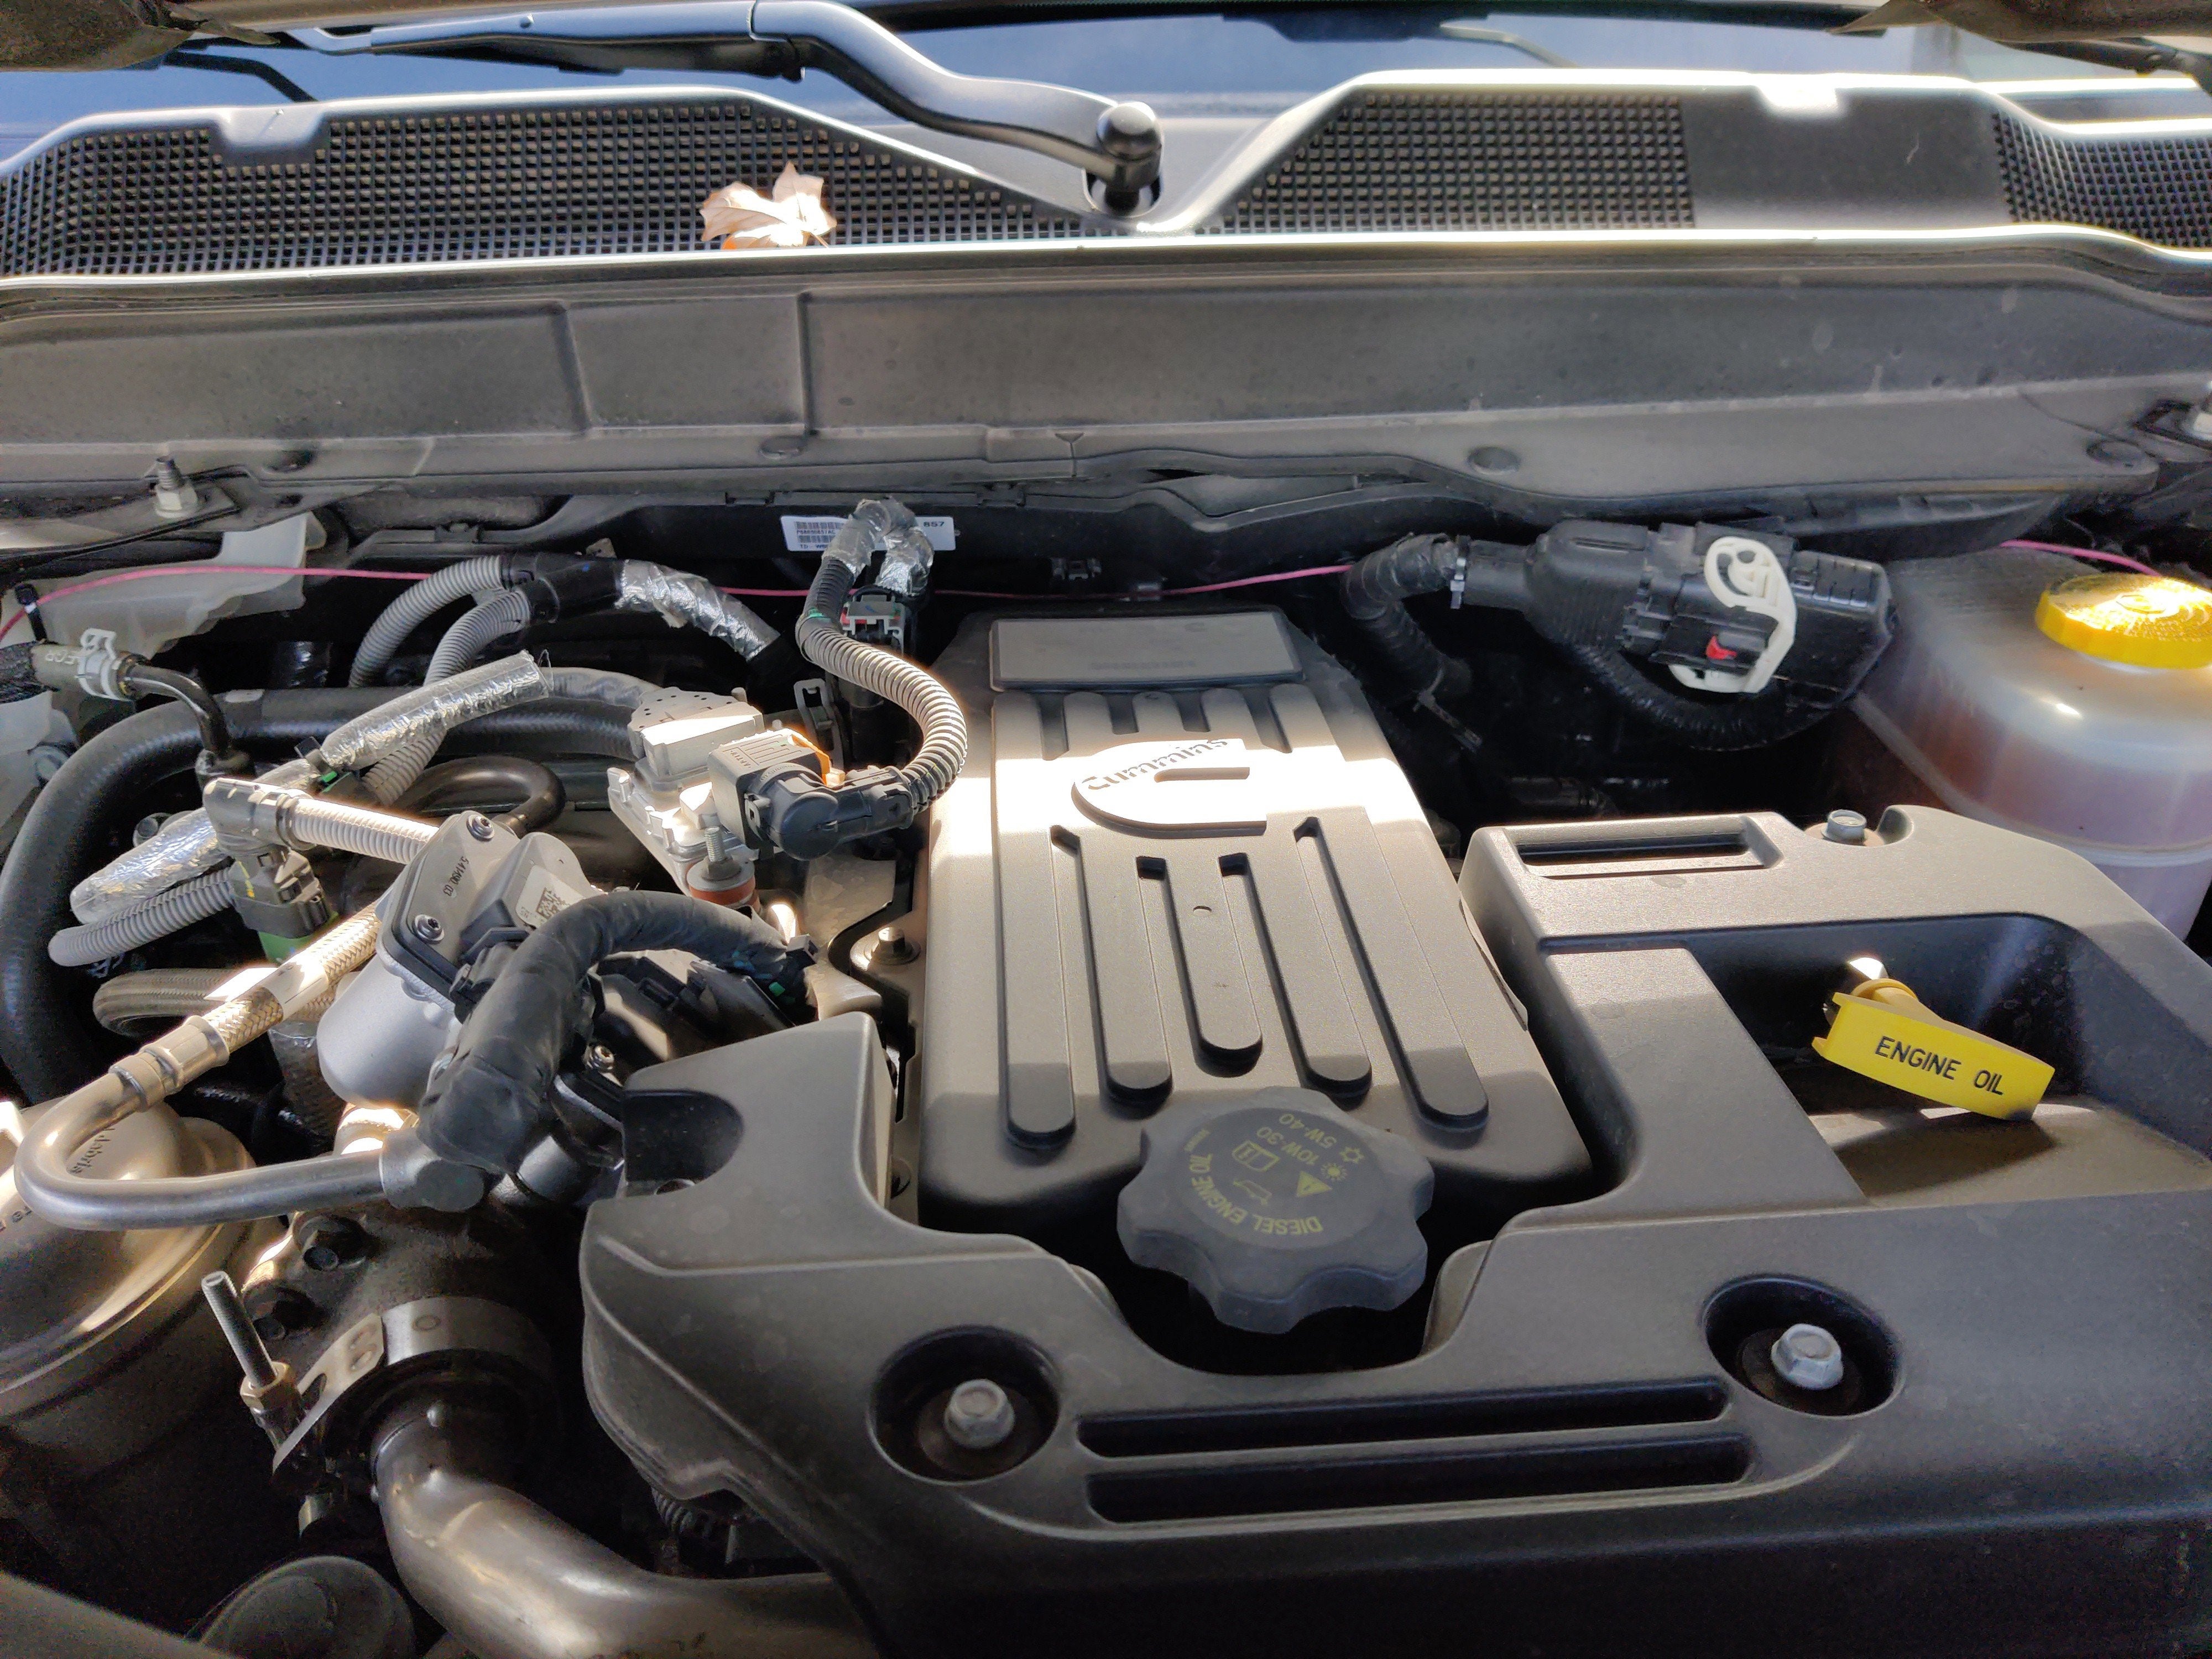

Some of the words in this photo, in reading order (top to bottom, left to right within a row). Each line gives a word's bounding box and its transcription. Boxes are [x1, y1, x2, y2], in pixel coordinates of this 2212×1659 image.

[1875, 1036, 1961, 1080] ENGINE
[1974, 1070, 2004, 1095] OIL
[1256, 1126, 1319, 1166] 10W-30
[1279, 1113, 1337, 1149] 5W-40
[1189, 1152, 1213, 1175] OIL
[1190, 1175, 1248, 1225] ENGINE
[1251, 1213, 1323, 1236] DIESEL
